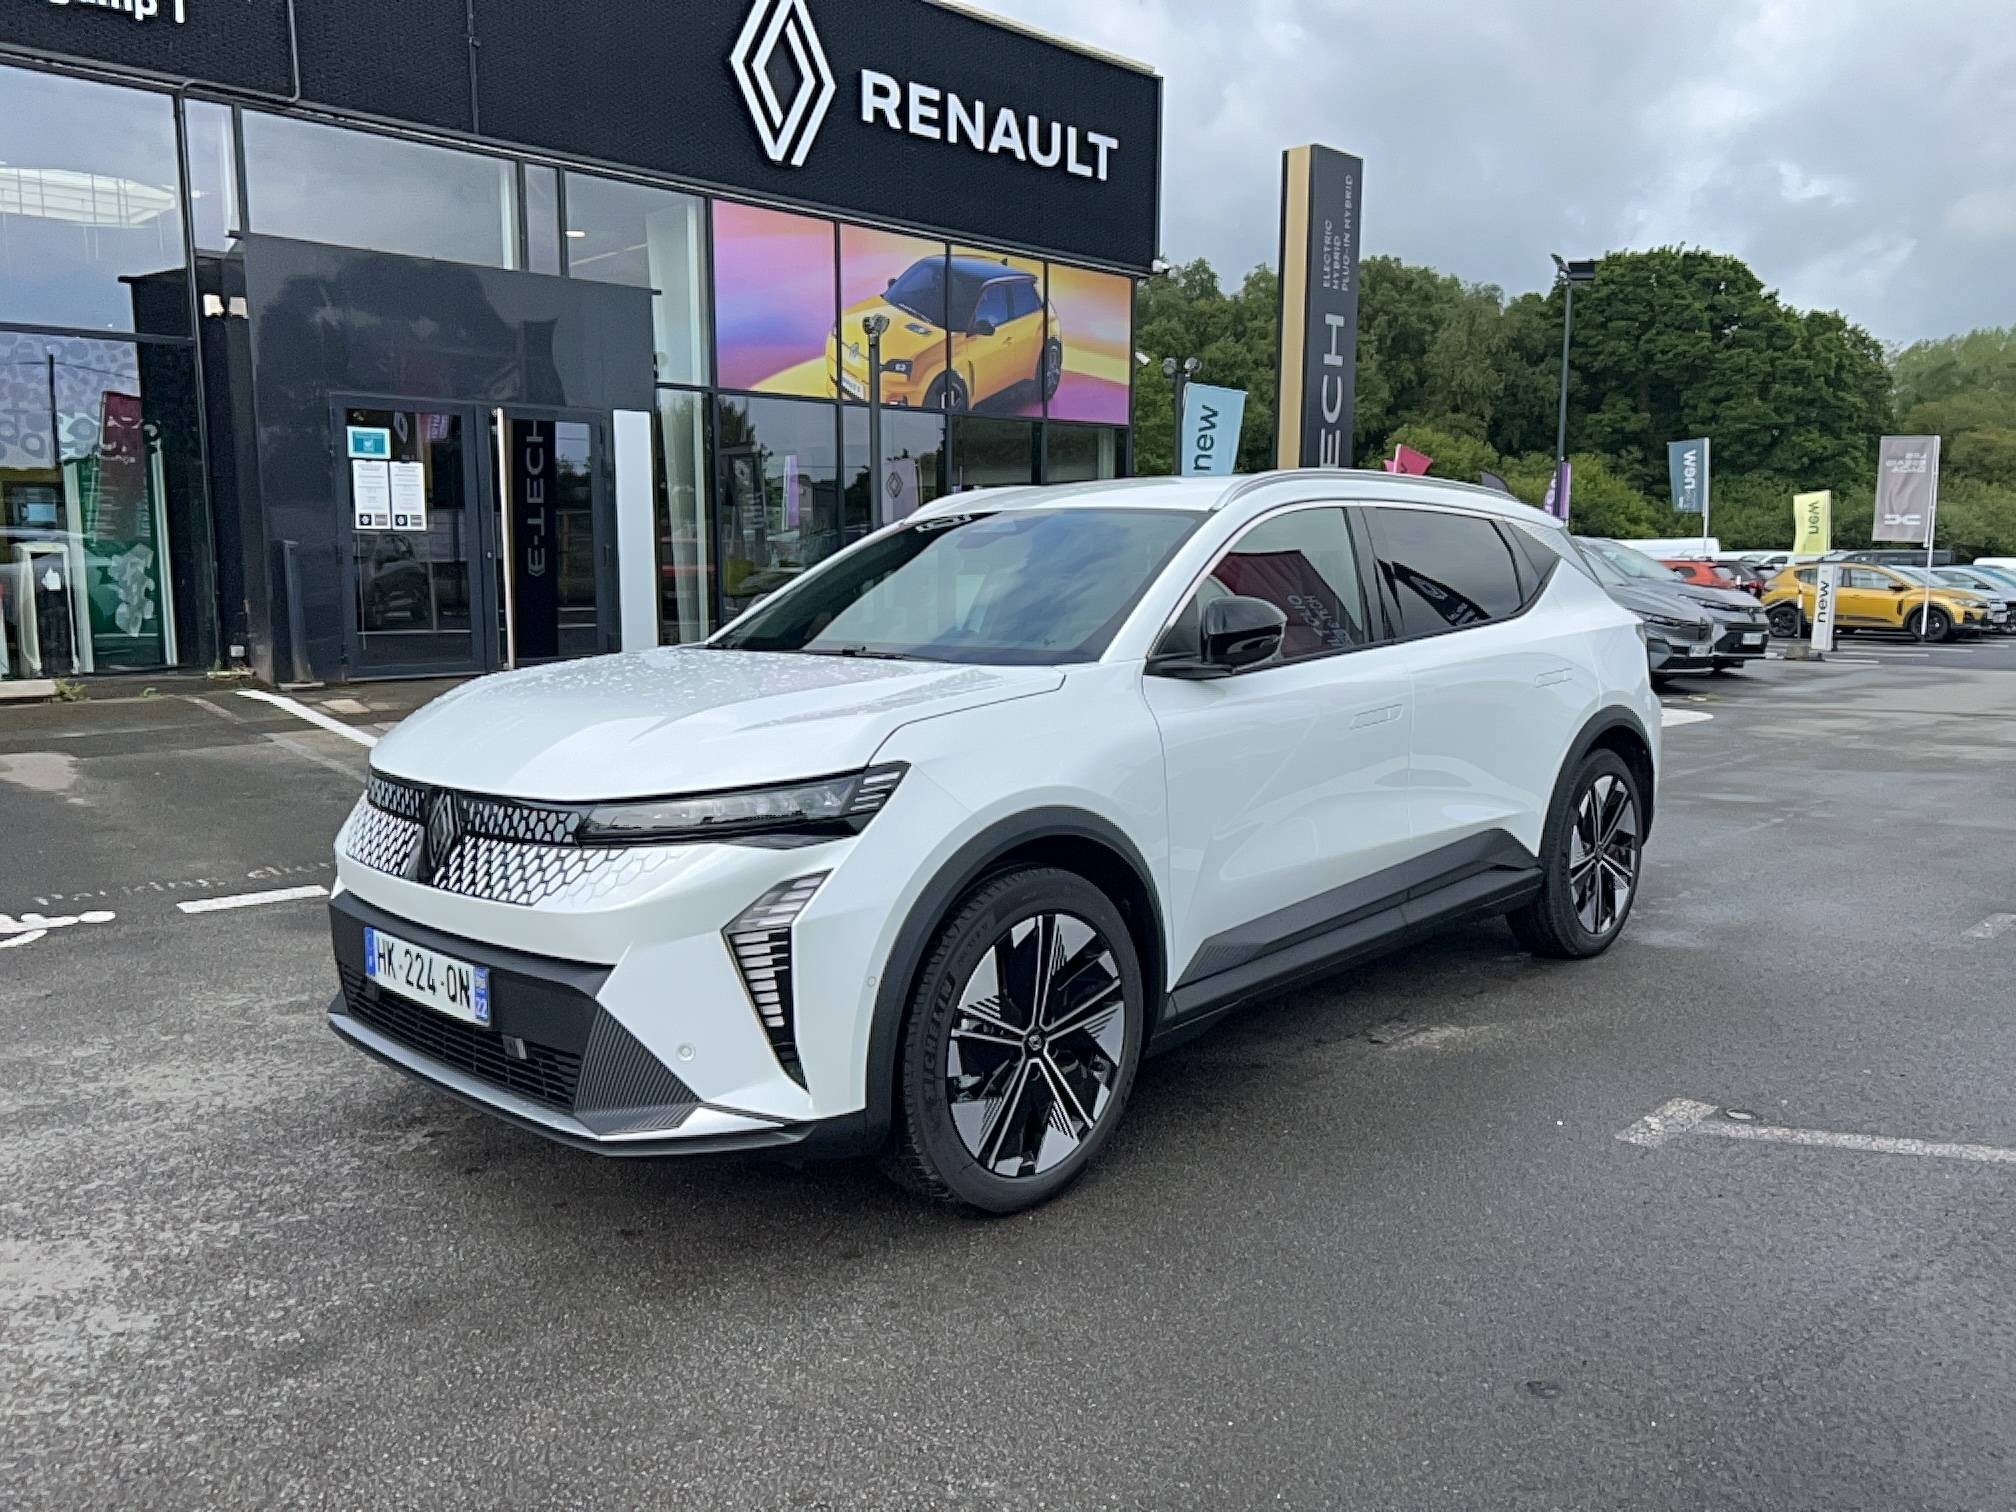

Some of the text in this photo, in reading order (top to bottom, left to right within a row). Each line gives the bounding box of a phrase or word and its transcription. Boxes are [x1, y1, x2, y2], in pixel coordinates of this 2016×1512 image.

[860, 68, 1120, 182] RENAULT
[1343, 174, 1354, 229] HYBRID
[1322, 219, 1333, 288] ELECTRIC
[1332, 235, 1342, 290] HYBRID
[1318, 312, 1346, 467] ECH
[1192, 404, 1220, 471] new
[1817, 580, 1830, 623] new
